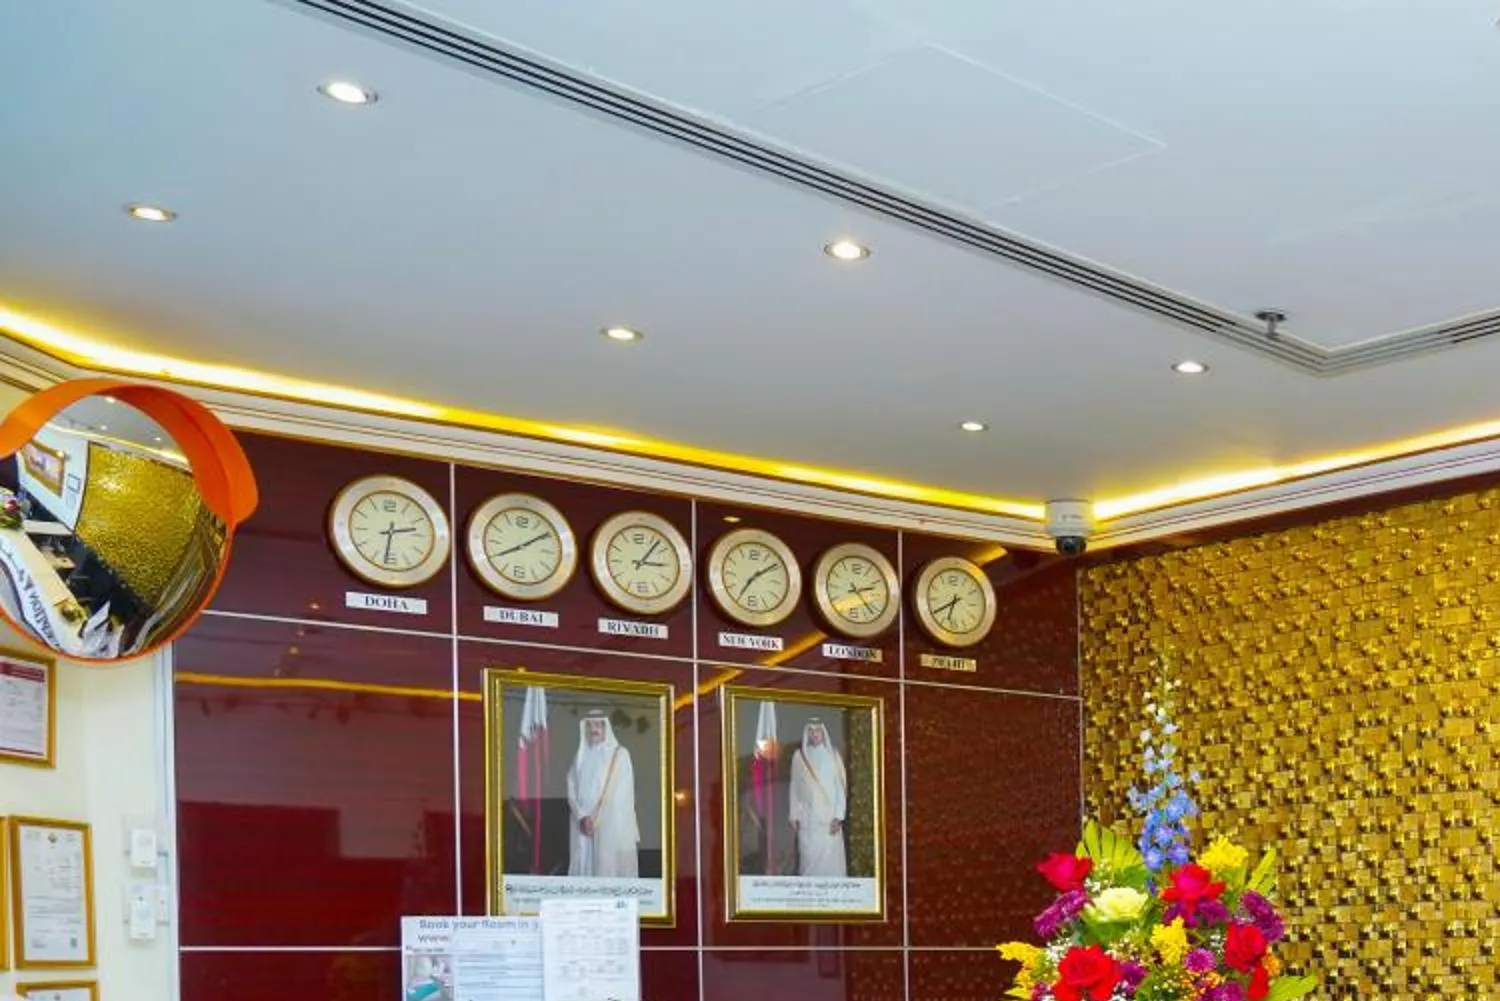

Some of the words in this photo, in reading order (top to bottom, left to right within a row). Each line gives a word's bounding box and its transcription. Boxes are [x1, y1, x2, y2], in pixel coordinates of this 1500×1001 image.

[364, 595, 409, 610] DOHA
[500, 609, 544, 624] DUBAI
[607, 621, 659, 636] RIYADH
[828, 645, 876, 658] LONDON
